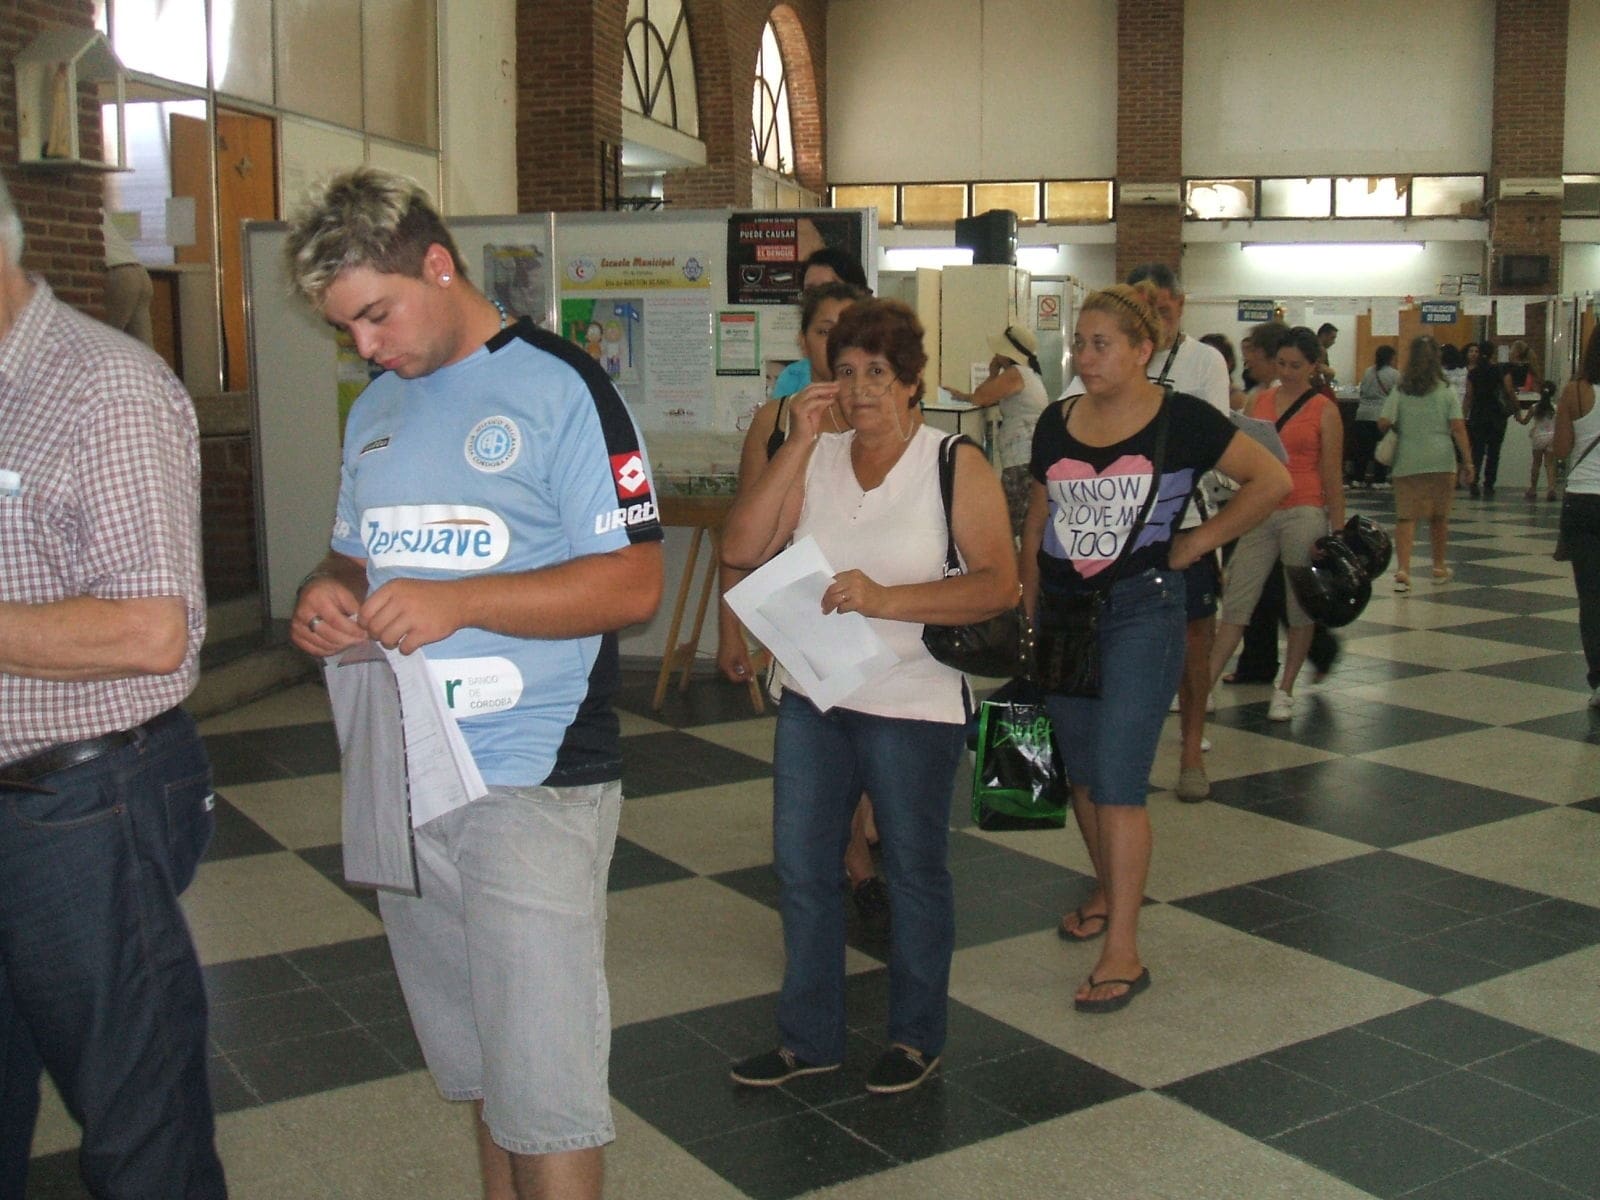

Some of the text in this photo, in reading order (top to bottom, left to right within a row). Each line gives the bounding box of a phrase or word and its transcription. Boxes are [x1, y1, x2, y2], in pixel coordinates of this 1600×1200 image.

[740, 230, 796, 239] PUEDE CAUSAR
[601, 257, 675, 269] Escuela Municipal
[1059, 476, 1141, 503] I KNOW
[1068, 504, 1113, 528] LOVE
[367, 520, 492, 558] Tersuave
[1070, 529, 1117, 557] TOO
[468, 688, 481, 698] DE
